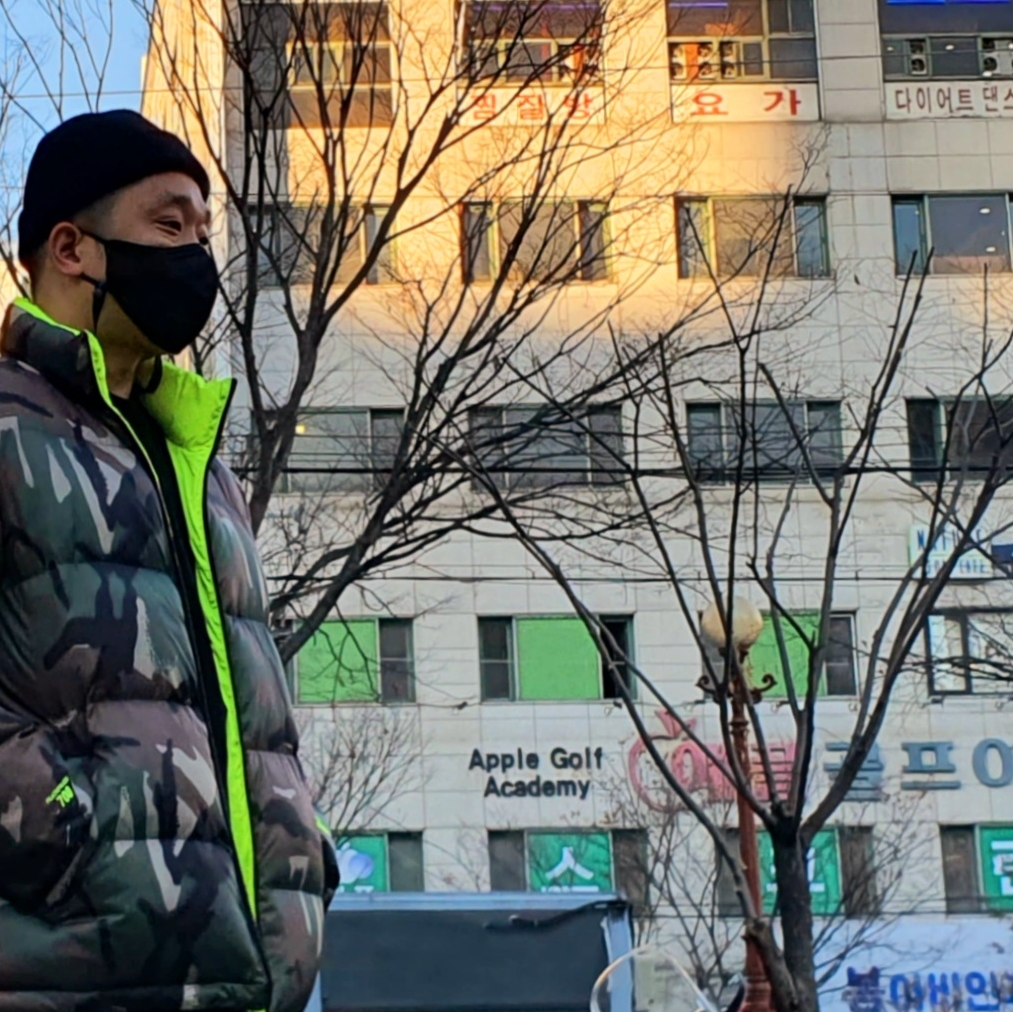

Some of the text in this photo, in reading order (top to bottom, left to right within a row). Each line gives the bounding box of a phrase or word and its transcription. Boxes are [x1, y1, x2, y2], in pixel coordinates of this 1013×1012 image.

[895, 86, 974, 114] 다이어트
[468, 746, 603, 773] Apple Golf
[483, 774, 591, 800] Academy
